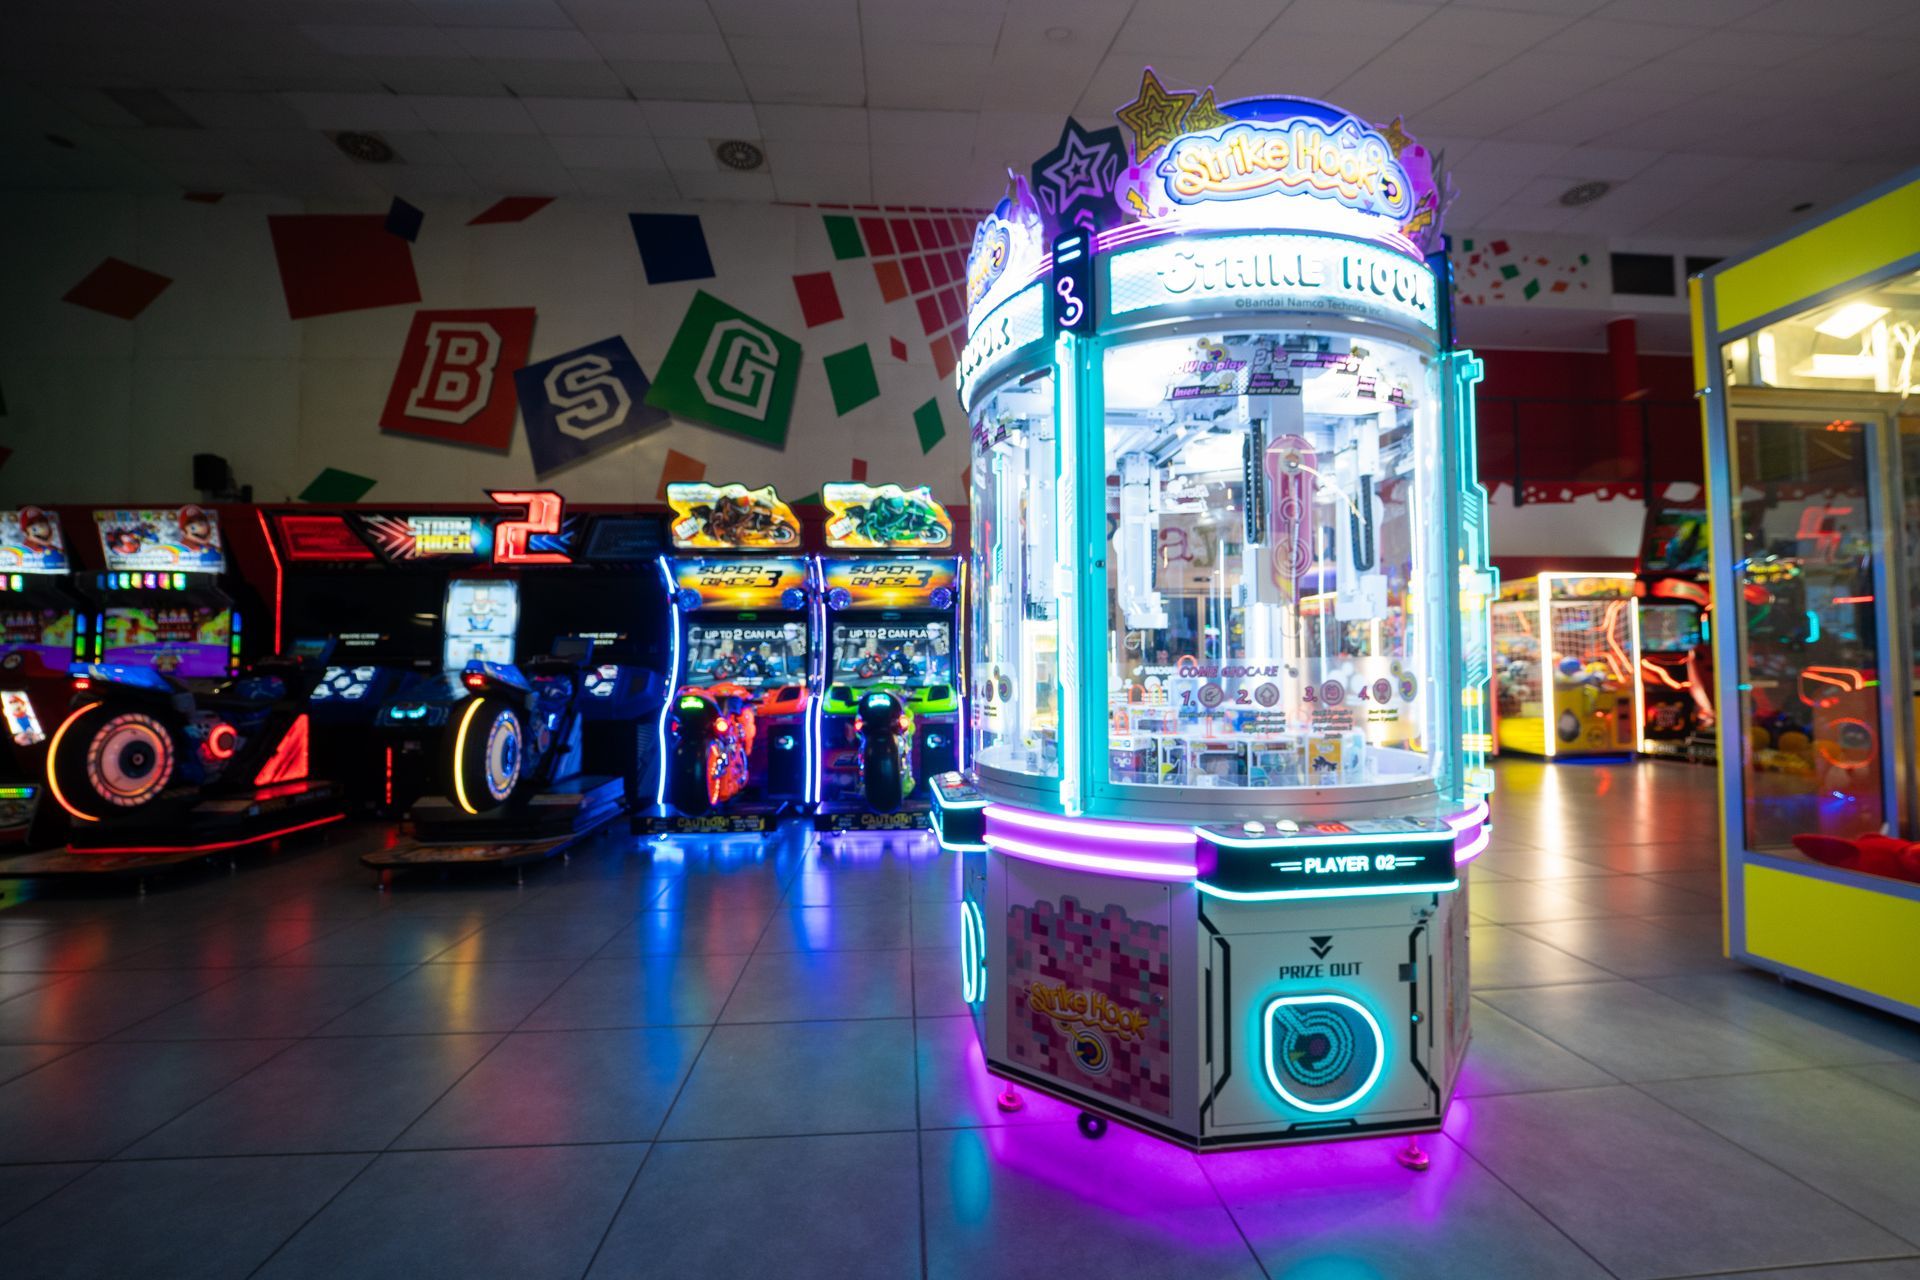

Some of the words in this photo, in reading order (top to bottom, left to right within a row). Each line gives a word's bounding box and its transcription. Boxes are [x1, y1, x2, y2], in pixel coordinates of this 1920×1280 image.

[1175, 132, 1290, 195] Strike
[1296, 129, 1379, 195] Hook
[1157, 252, 1325, 294] STRIKE
[1287, 298, 1325, 309] Namco
[1327, 299, 1368, 315] Technica
[404, 321, 502, 425] B
[694, 318, 779, 422] G
[1199, 362, 1214, 372] to
[1215, 358, 1248, 373] play
[543, 353, 632, 441] S
[1174, 386, 1200, 397] Insert
[415, 535, 474, 556] RIDER
[696, 565, 763, 575] SUPER
[753, 570, 783, 588] 3
[848, 565, 914, 575] SUPER
[902, 569, 934, 588] 3
[704, 630, 720, 640] UP
[720, 630, 733, 640] TO
[733, 628, 743, 641] 2
[743, 630, 765, 640] CAN
[765, 630, 789, 640] PLAY
[849, 629, 864, 639] UP
[864, 629, 877, 639] TO
[877, 628, 887, 640] 2
[888, 629, 909, 639] CAN
[909, 629, 931, 639] PLAY
[1179, 665, 1218, 678] COME
[1221, 665, 1280, 678] GIOCARE
[1304, 857, 1370, 874] PLAYER
[1375, 854, 1397, 871] 02
[1279, 963, 1324, 980] PRIZE
[1329, 961, 1363, 978] OUT
[1028, 980, 1088, 1014] Strike
[1090, 990, 1150, 1041] Hook
